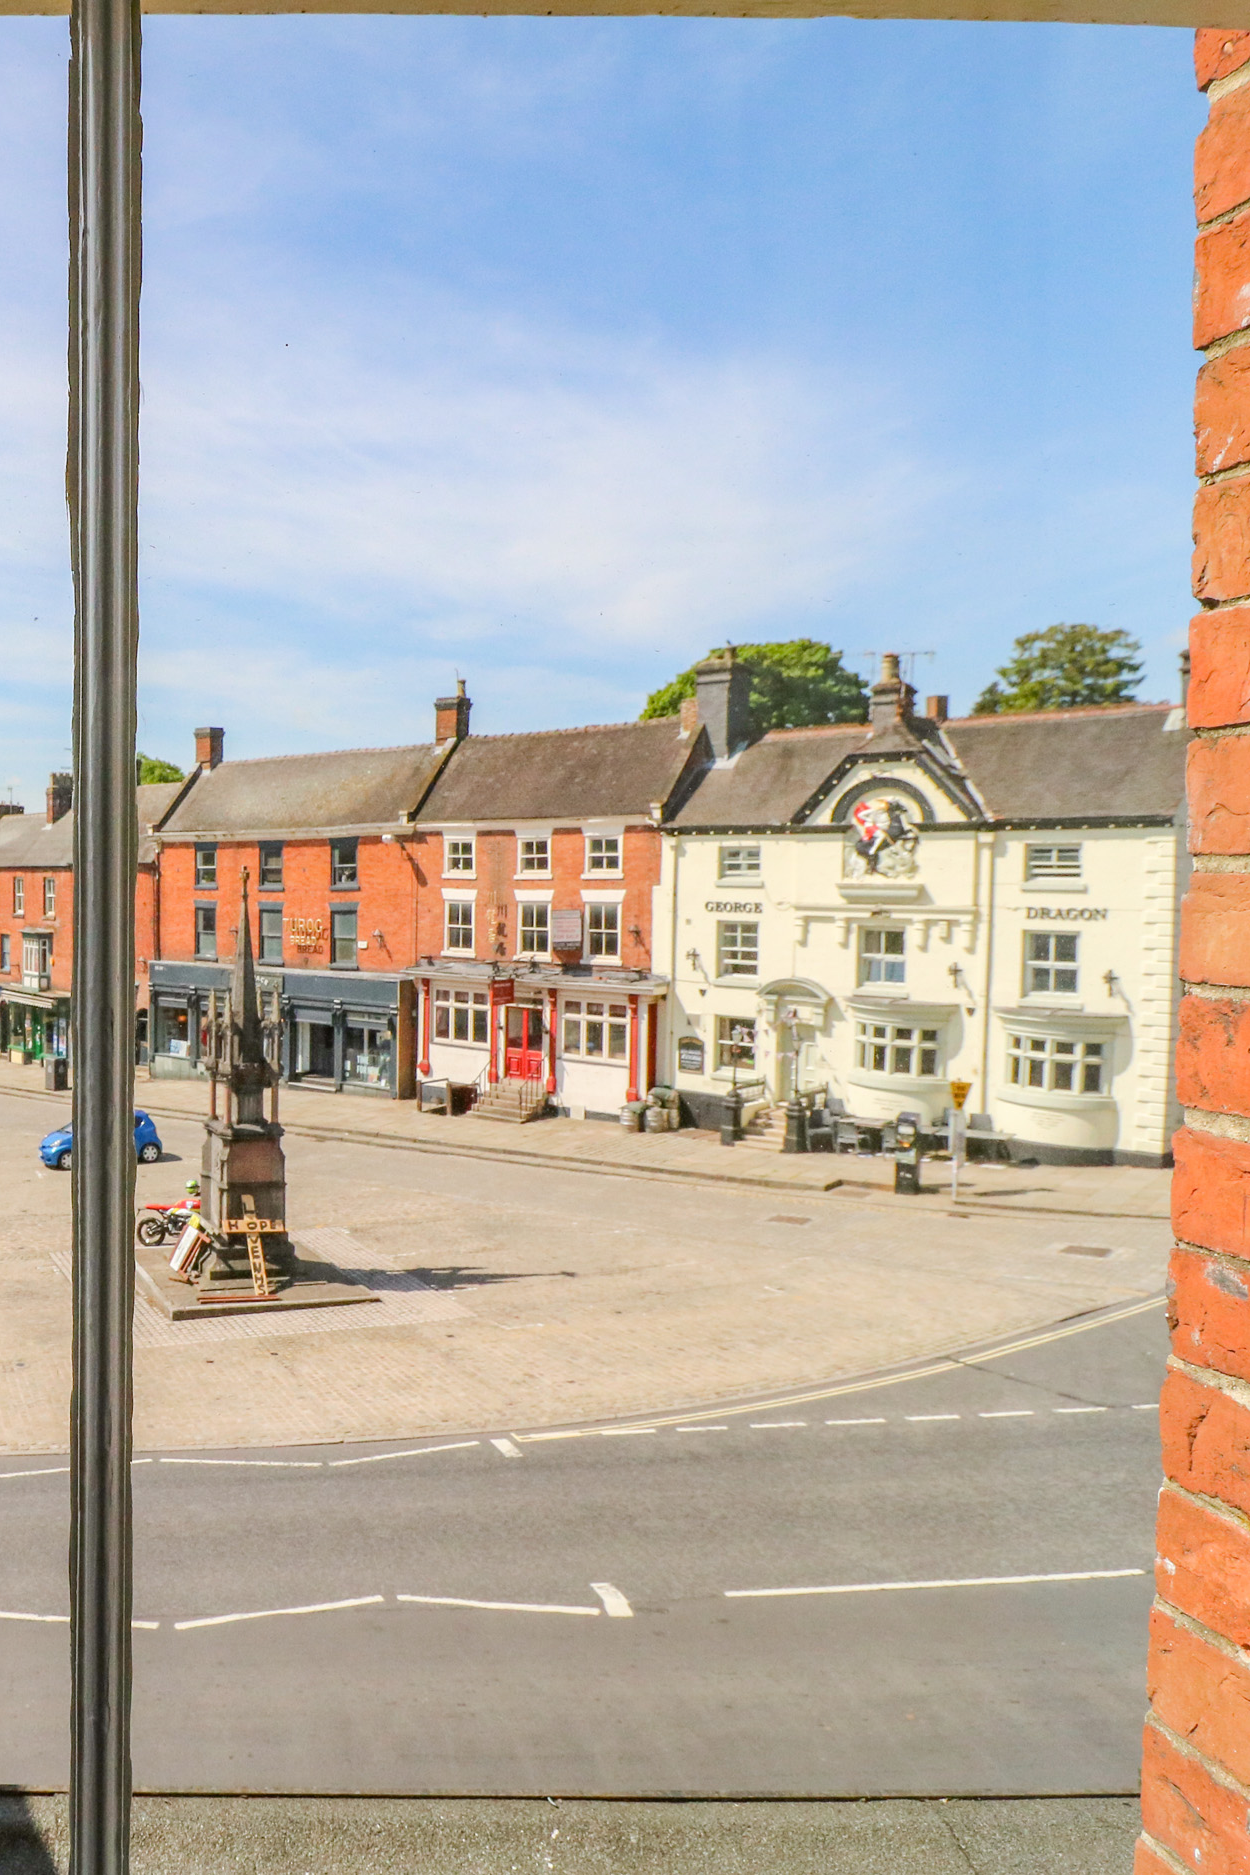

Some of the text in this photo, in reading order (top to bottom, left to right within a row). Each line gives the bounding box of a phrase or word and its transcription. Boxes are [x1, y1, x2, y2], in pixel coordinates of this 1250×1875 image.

[705, 901, 763, 913] GEORGE
[1026, 907, 1108, 921] DRAGON
[282, 917, 323, 932] TUROG
[290, 935, 317, 946] BREAD
[228, 1220, 279, 1231] HOPE
